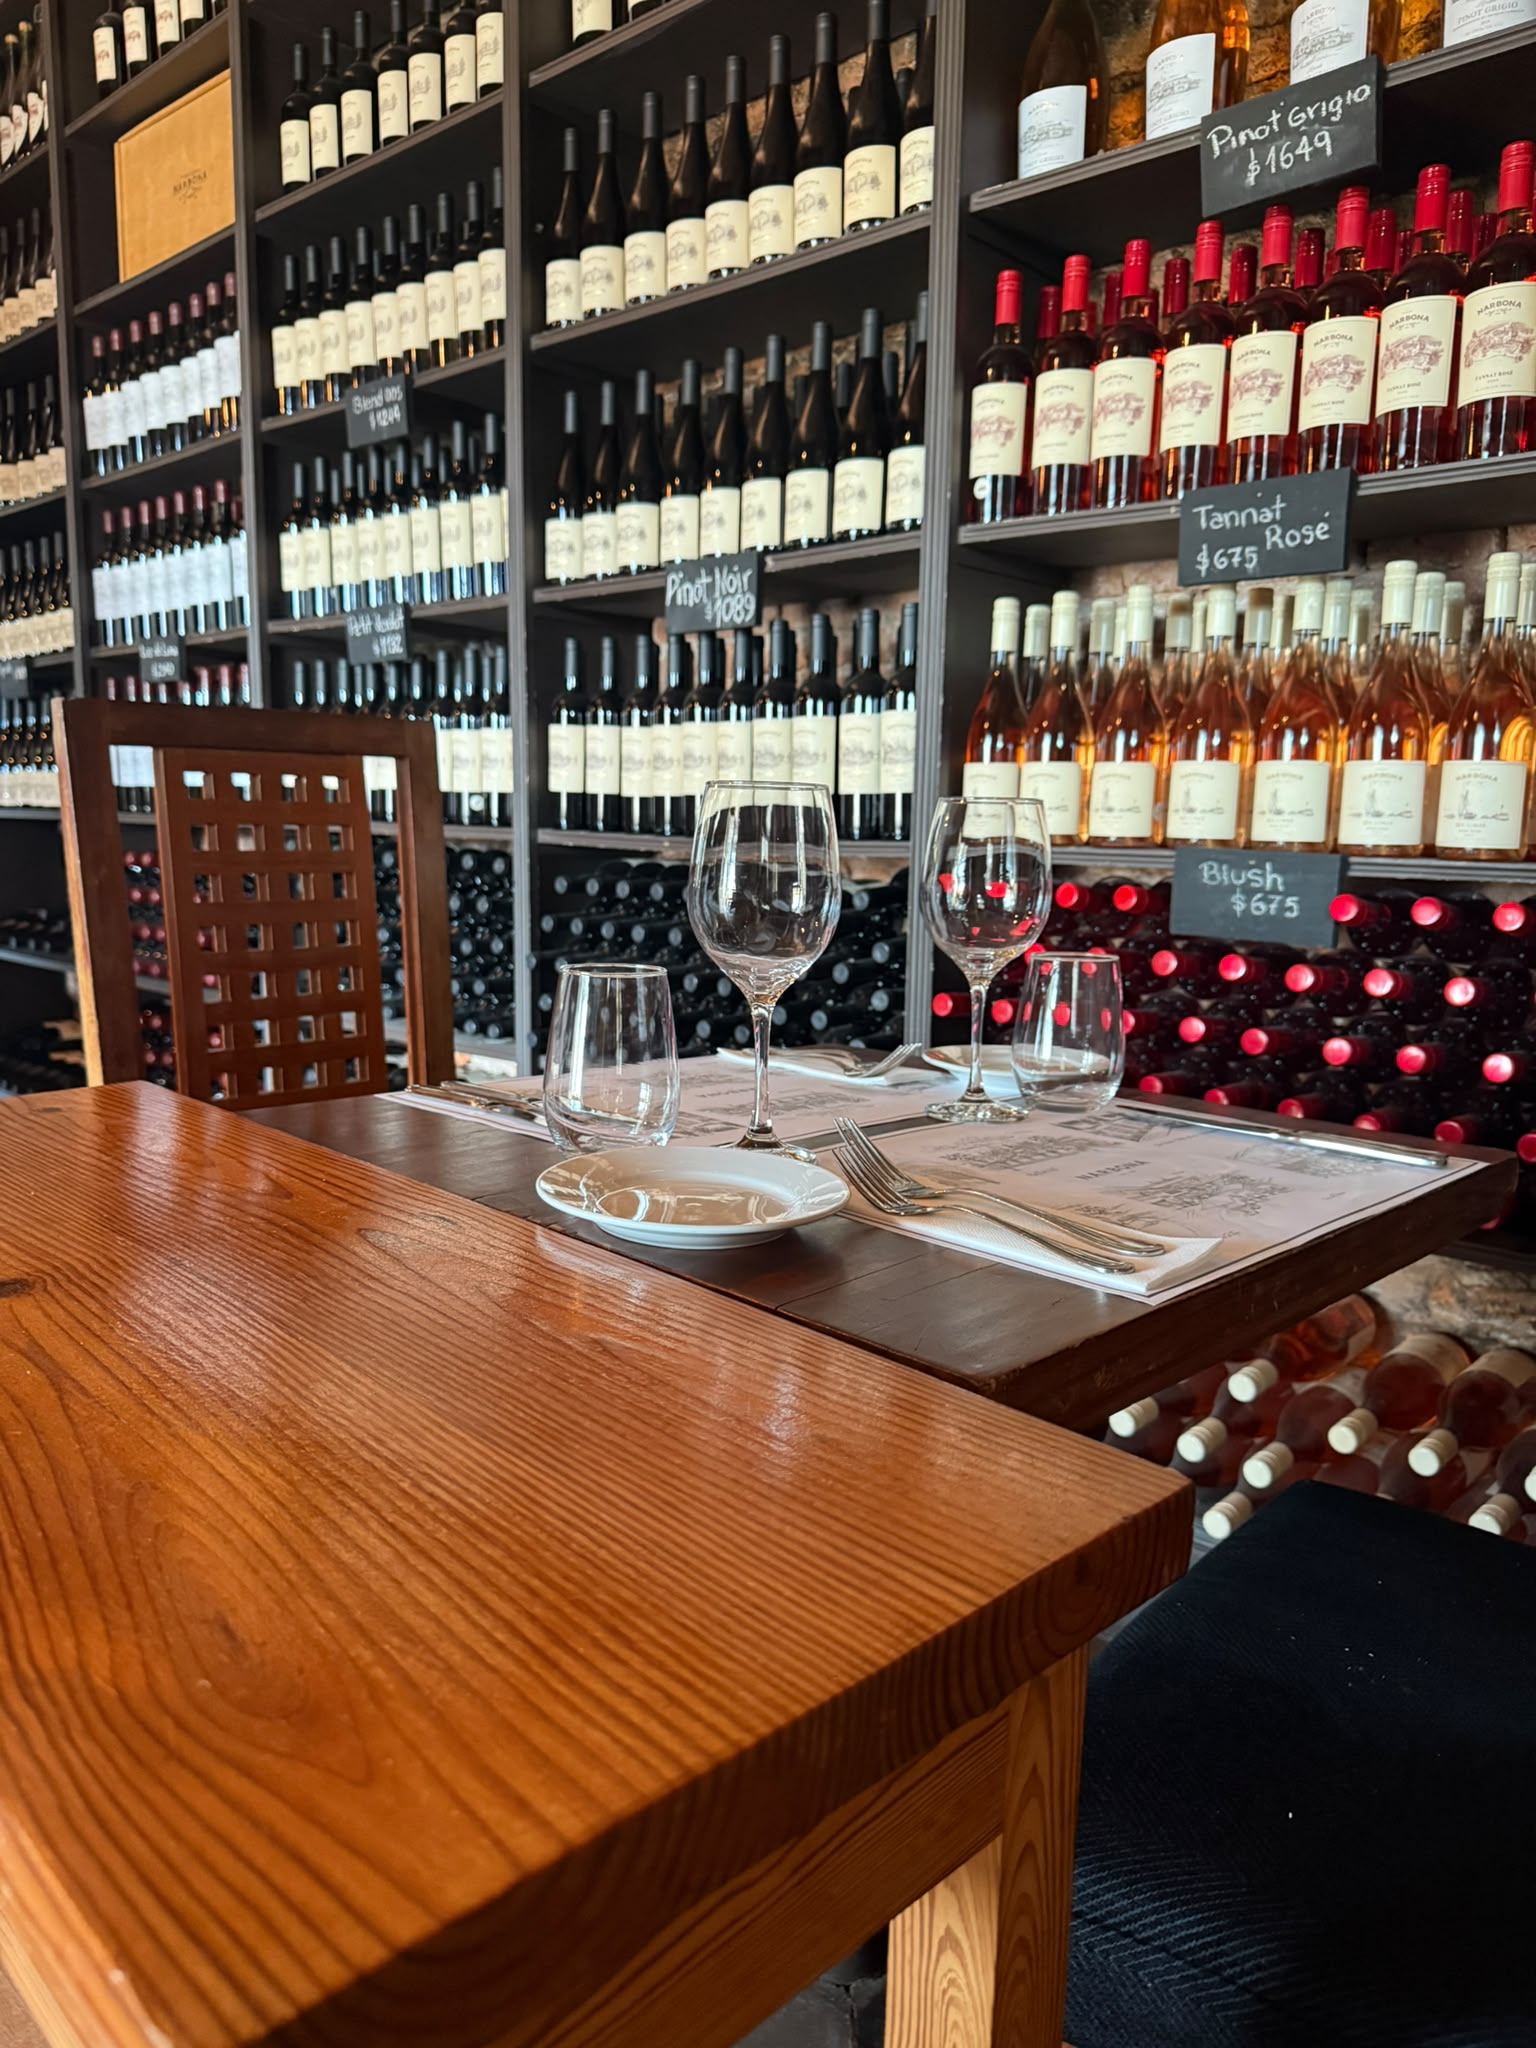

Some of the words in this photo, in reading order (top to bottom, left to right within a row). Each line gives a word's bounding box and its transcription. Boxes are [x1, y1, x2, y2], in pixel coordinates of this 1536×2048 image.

[1484, 1, 1519, 14] GRIGIO
[1206, 109, 1281, 159] Pinot
[1287, 84, 1372, 127] Grigio
[1245, 130, 1333, 186] $1649
[1388, 313, 1430, 329] NARBONA
[1476, 299, 1522, 316] NARBONA
[1313, 333, 1354, 347] NARBONA
[351, 387, 384, 415] Blend
[1191, 493, 1288, 530] Tannat
[1265, 511, 1331, 551] Rosé
[1195, 543, 1260, 578] $675
[665, 566, 713, 608] Pinot
[713, 563, 754, 598] Noir
[703, 591, 756, 629] $1089
[1197, 860, 1286, 892] Blush
[1230, 887, 1301, 918] $675
[1073, 1160, 1151, 1181] NARBONA
